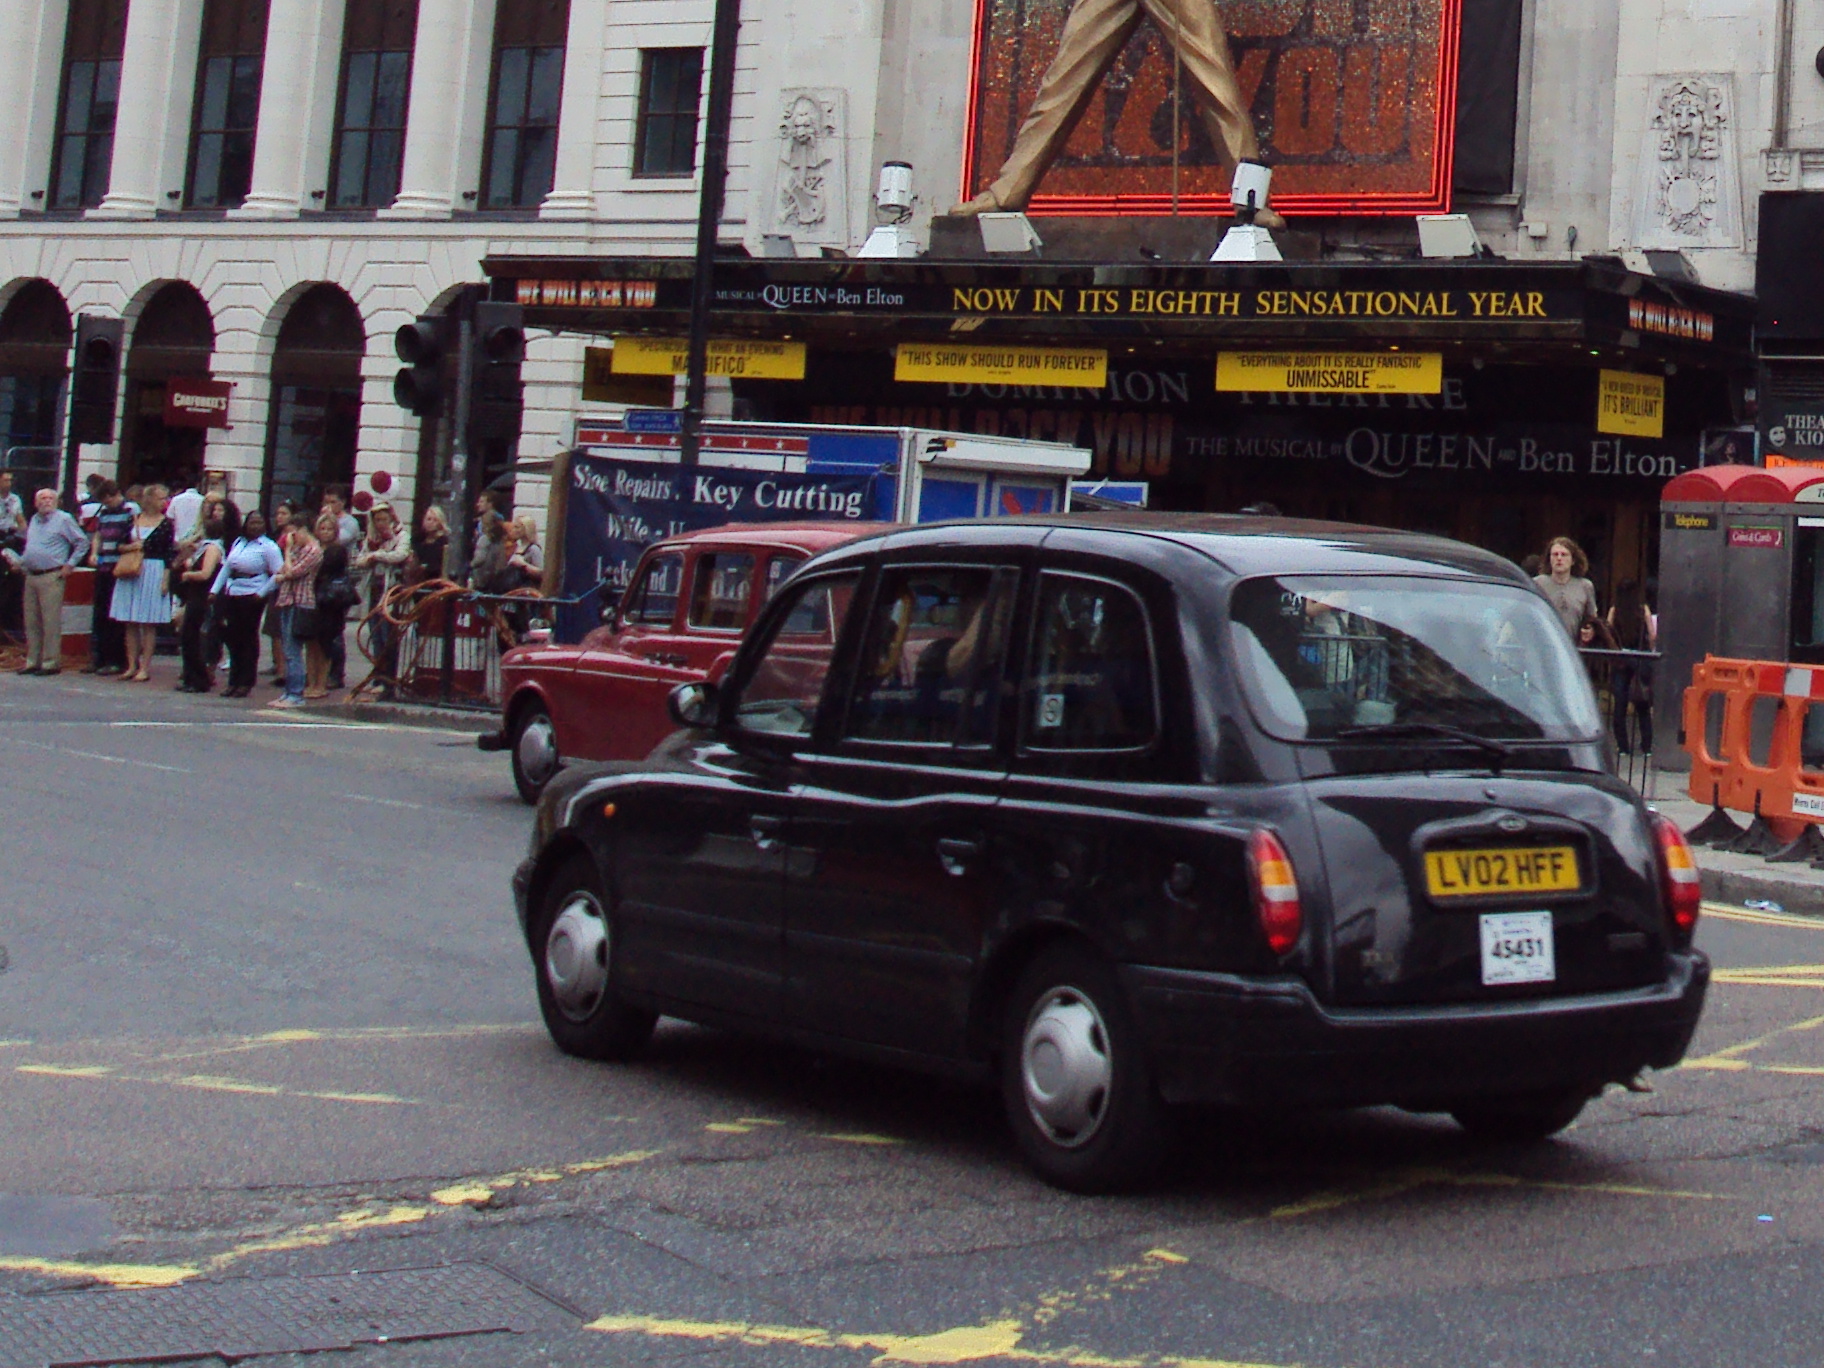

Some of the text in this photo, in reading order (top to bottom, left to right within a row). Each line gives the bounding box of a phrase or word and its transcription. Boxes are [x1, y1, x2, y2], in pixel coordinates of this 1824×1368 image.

[762, 284, 828, 309] QUEEN
[836, 288, 861, 305] Ben
[866, 288, 905, 305] Elton
[952, 288, 1547, 317] NOW IN ITS EIGHTH SENSATIONAL YEAR
[936, 352, 967, 367] SHOW
[971, 353, 1014, 368] SHOULD
[1018, 354, 1041, 368] RUN
[1293, 356, 1321, 368] ABOUT
[1324, 357, 1331, 367] IT
[1334, 357, 1343, 368] IS
[1344, 357, 1375, 368] REALLY
[1377, 356, 1422, 369] FANTASTIC
[1186, 437, 1227, 456] THE
[1233, 438, 1329, 459] MUSICAL
[1344, 428, 1496, 478] QUEEN
[1518, 438, 1575, 474] Ben
[1590, 440, 1678, 477] Elton
[693, 475, 743, 511] Key
[755, 481, 863, 519] Cutting
[1674, 514, 1709, 531] Telephone
[1437, 852, 1564, 889] LV02 HFF
[1490, 938, 1544, 959] 45431
